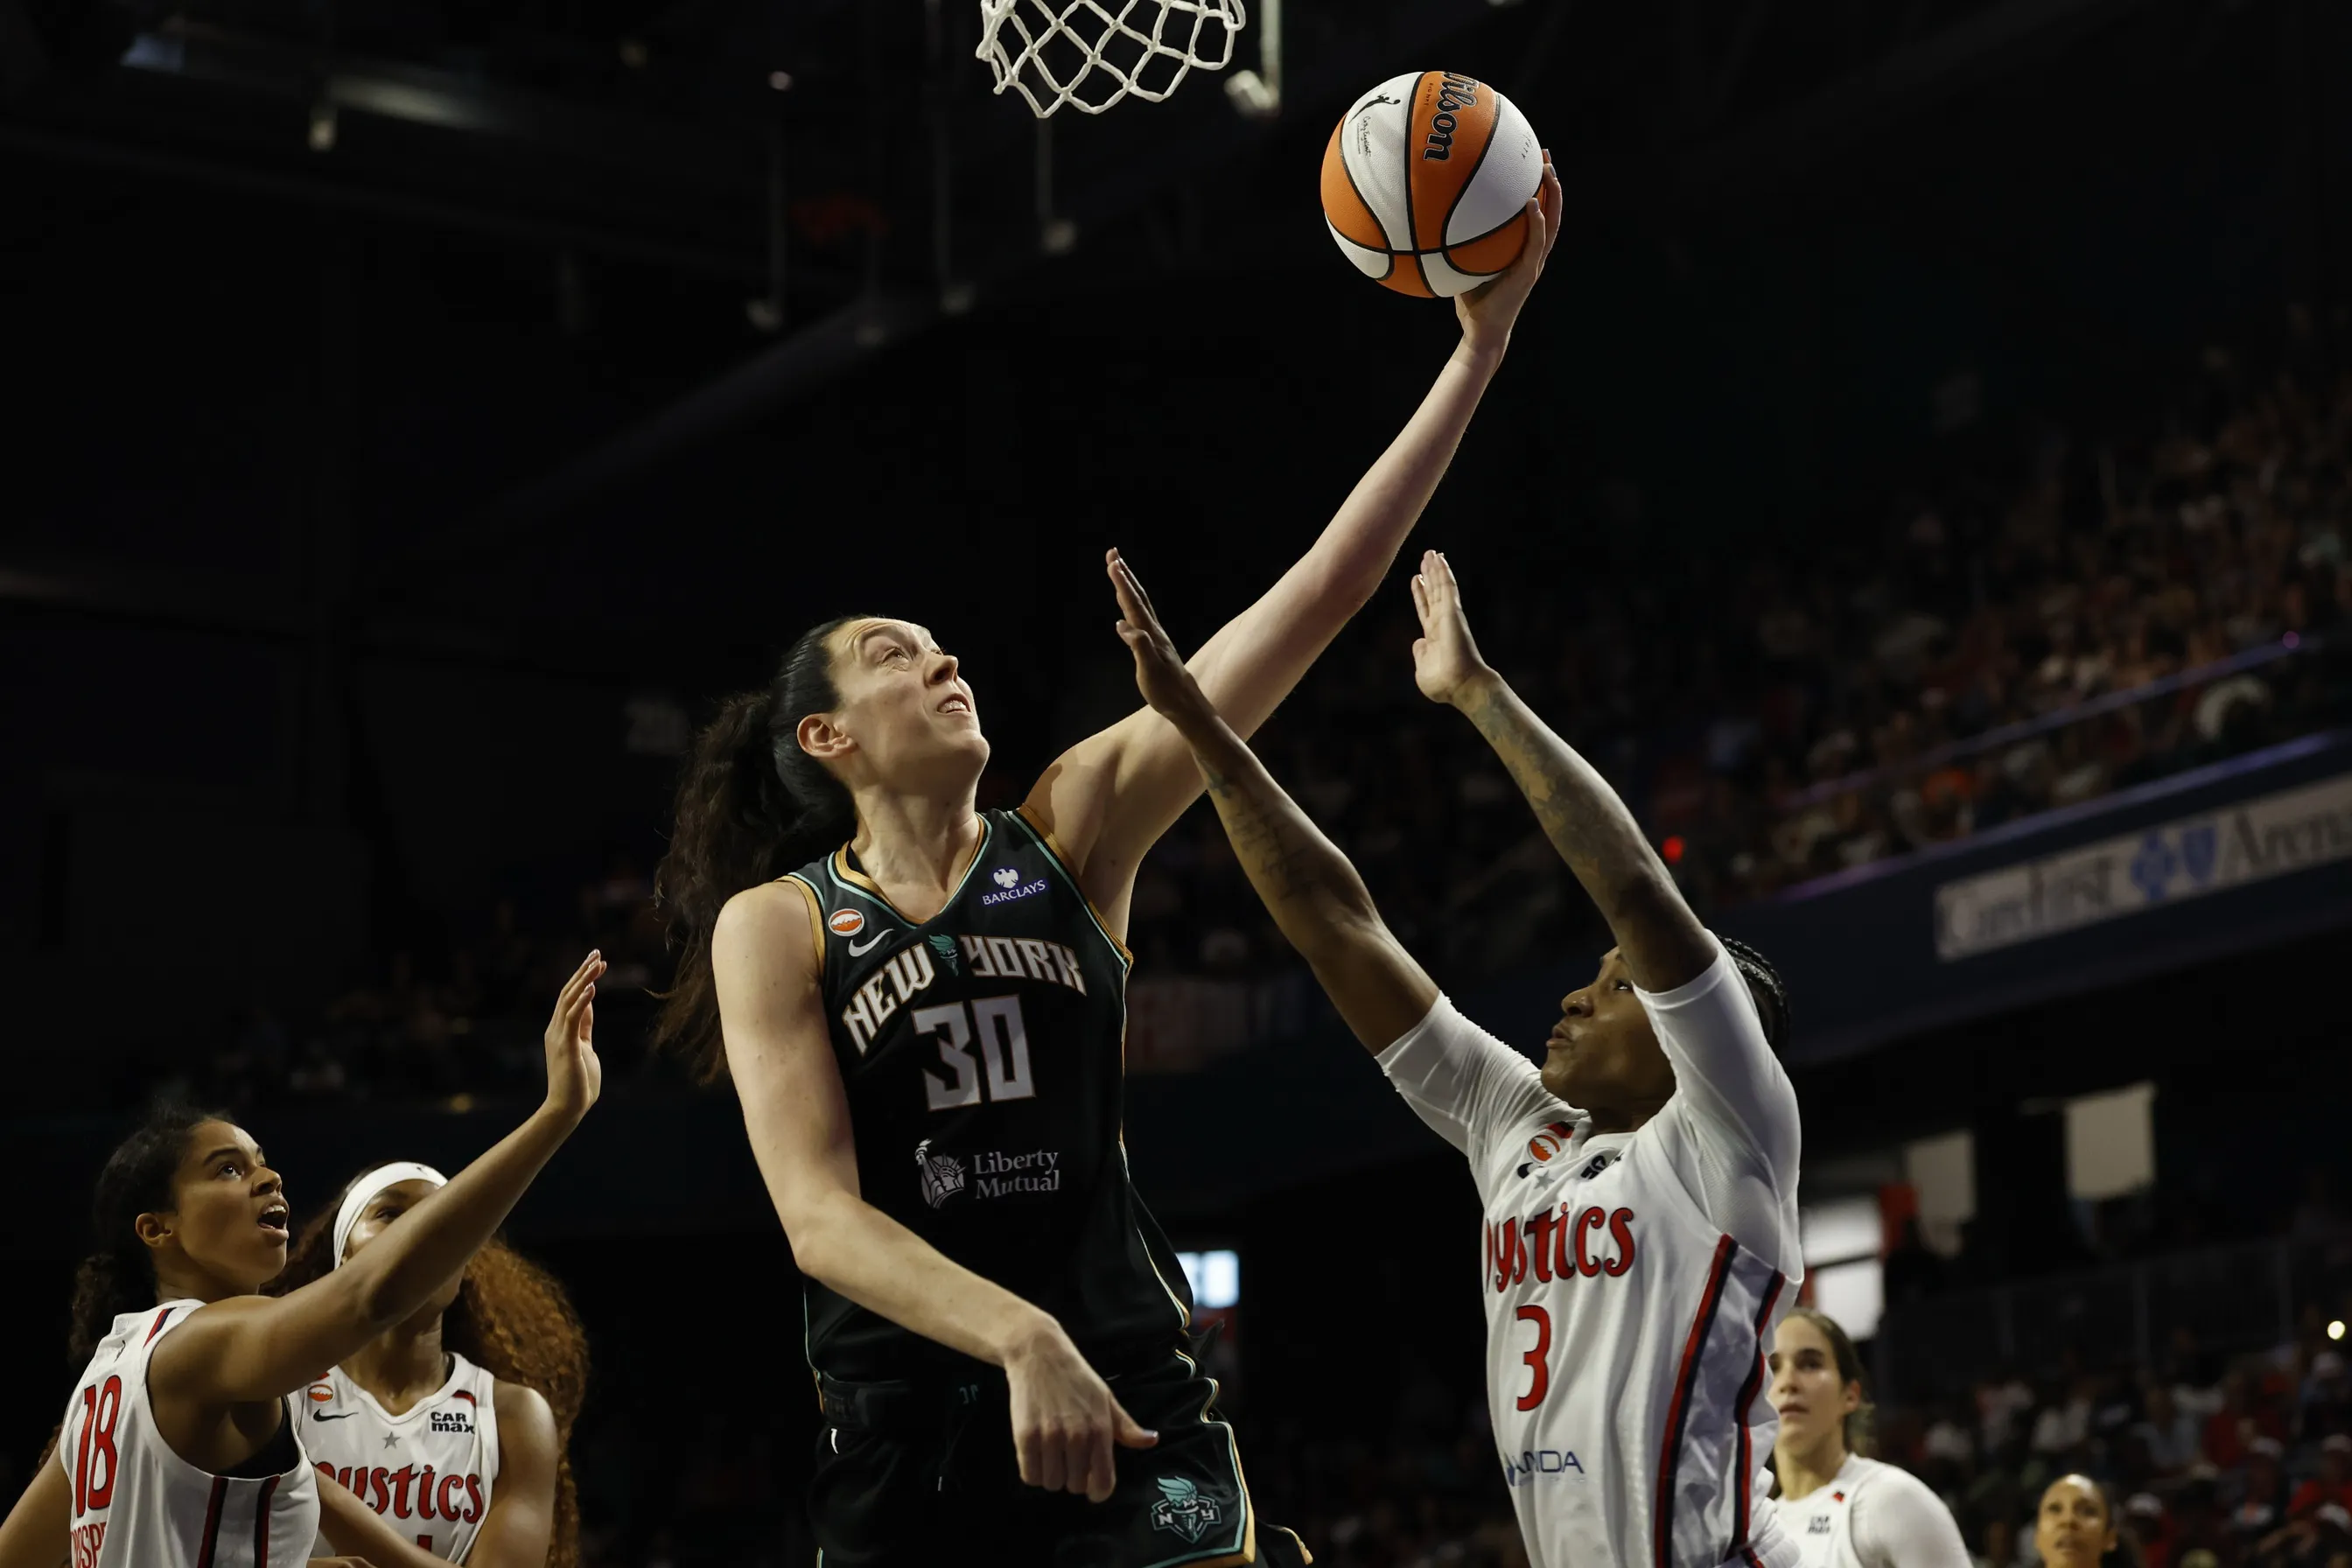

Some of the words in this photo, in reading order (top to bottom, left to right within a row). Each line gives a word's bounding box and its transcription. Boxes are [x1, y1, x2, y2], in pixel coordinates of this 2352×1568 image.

[982, 879, 1046, 906] BARCLAYS
[842, 942, 935, 1057] NEW
[960, 934, 1088, 998] YORK
[911, 994, 1037, 1112] 30
[973, 1151, 1060, 1179] Liberty
[975, 1170, 1060, 1200] Mutual
[1516, 1304, 1552, 1412] 3
[430, 1411, 467, 1423] CAR
[431, 1422, 475, 1434] max
[75, 1374, 122, 1519] 18
[312, 1461, 484, 1525] ystics
